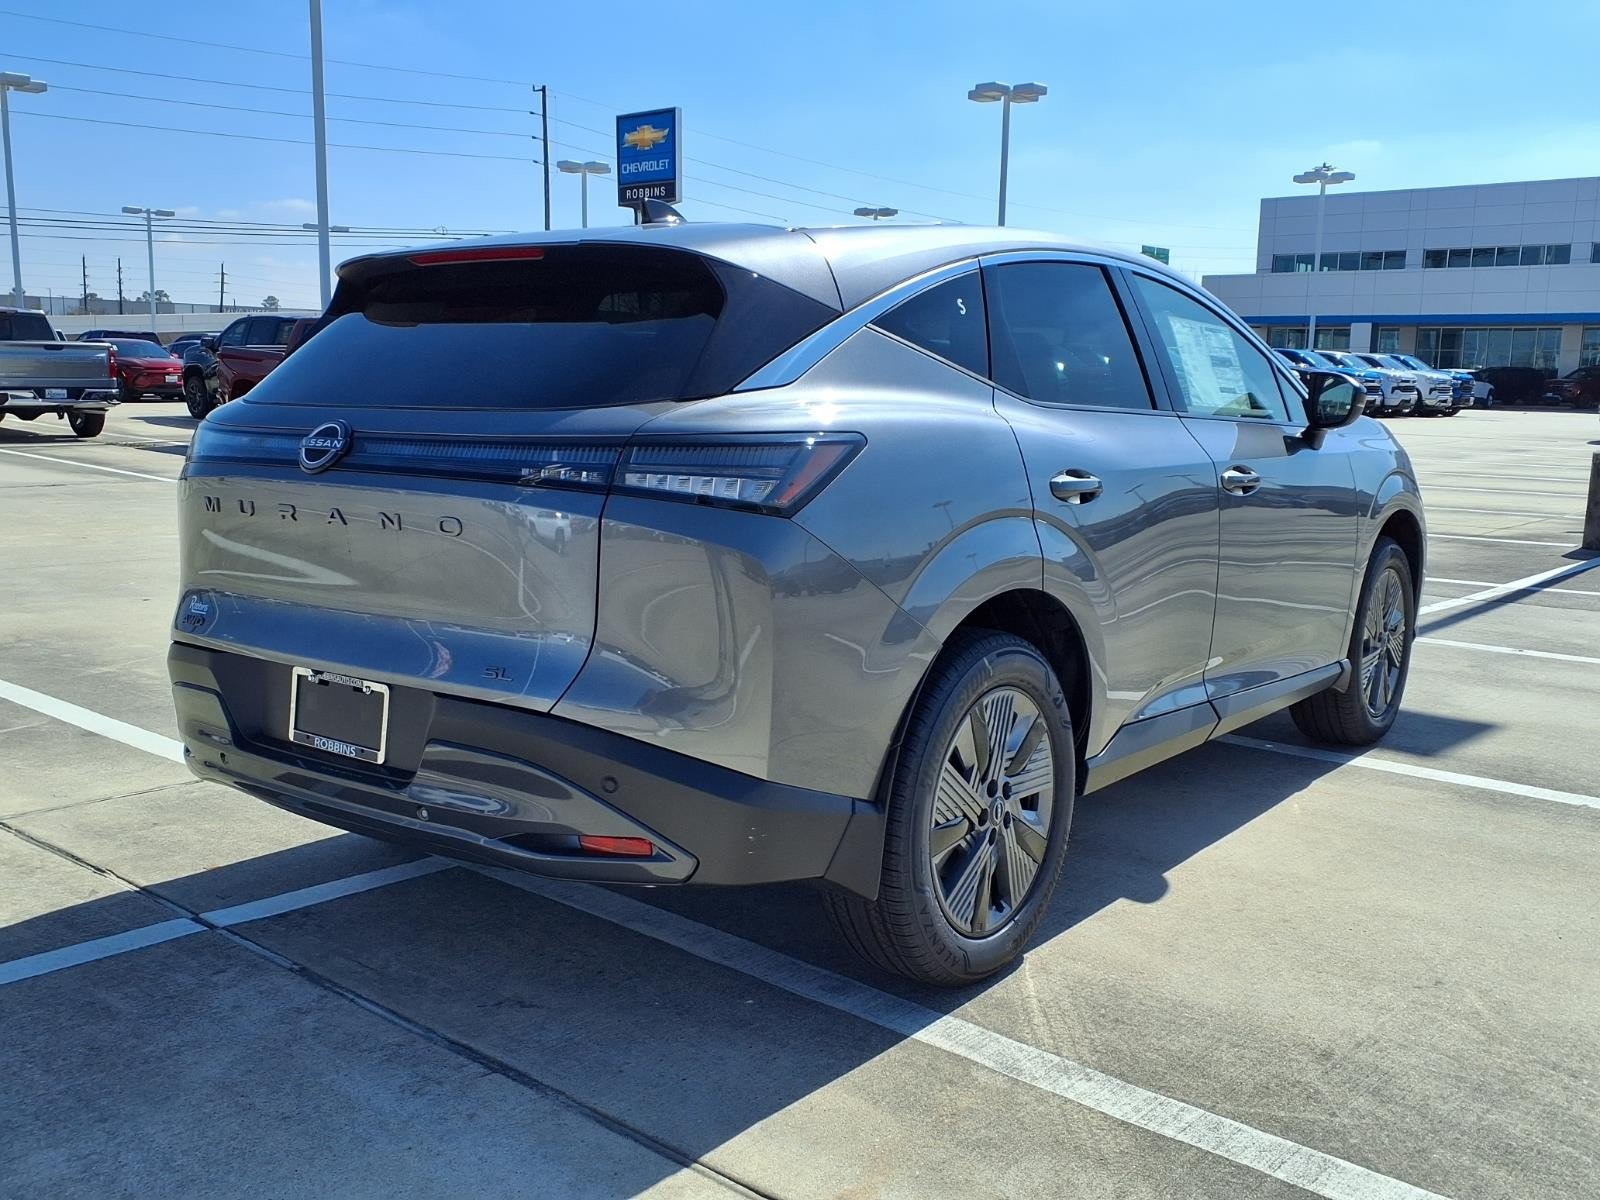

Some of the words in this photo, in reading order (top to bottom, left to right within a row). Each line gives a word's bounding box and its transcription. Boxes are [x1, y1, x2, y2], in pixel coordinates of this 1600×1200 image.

[621, 159, 670, 174] CHEVROLET
[626, 186, 666, 200] ROBBINS
[304, 438, 343, 448] ISSAN
[203, 496, 464, 537] MURANO
[480, 665, 513, 681] SL
[314, 737, 356, 757] ROBBINS
